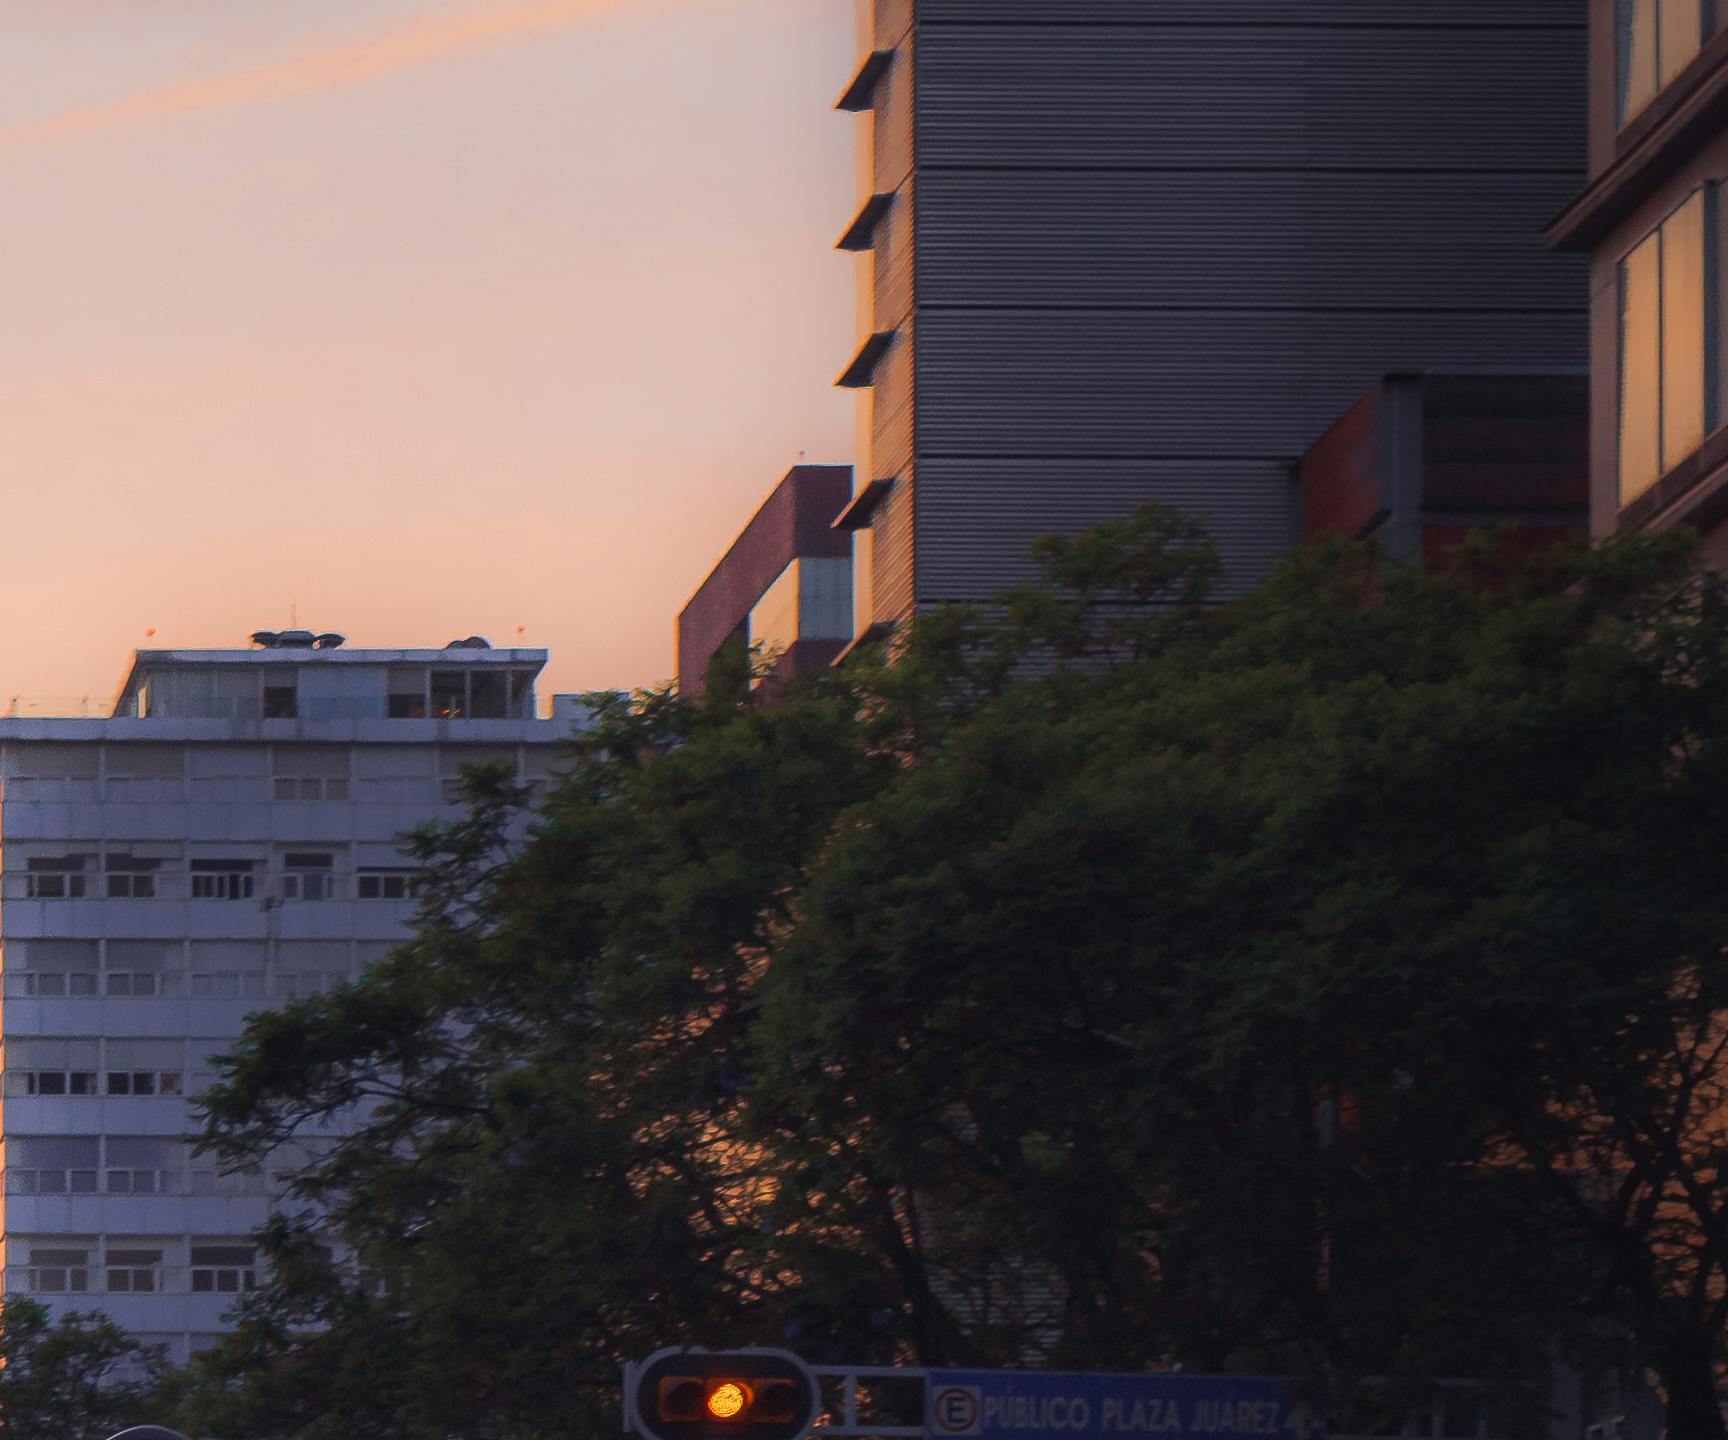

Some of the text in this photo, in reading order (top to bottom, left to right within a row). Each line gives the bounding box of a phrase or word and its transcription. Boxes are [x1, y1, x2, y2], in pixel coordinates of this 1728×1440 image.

[983, 1386, 1089, 1431] PÚBLICO
[1102, 1397, 1181, 1433] PLAZA
[1190, 1391, 1280, 1434] JUÁREZ
